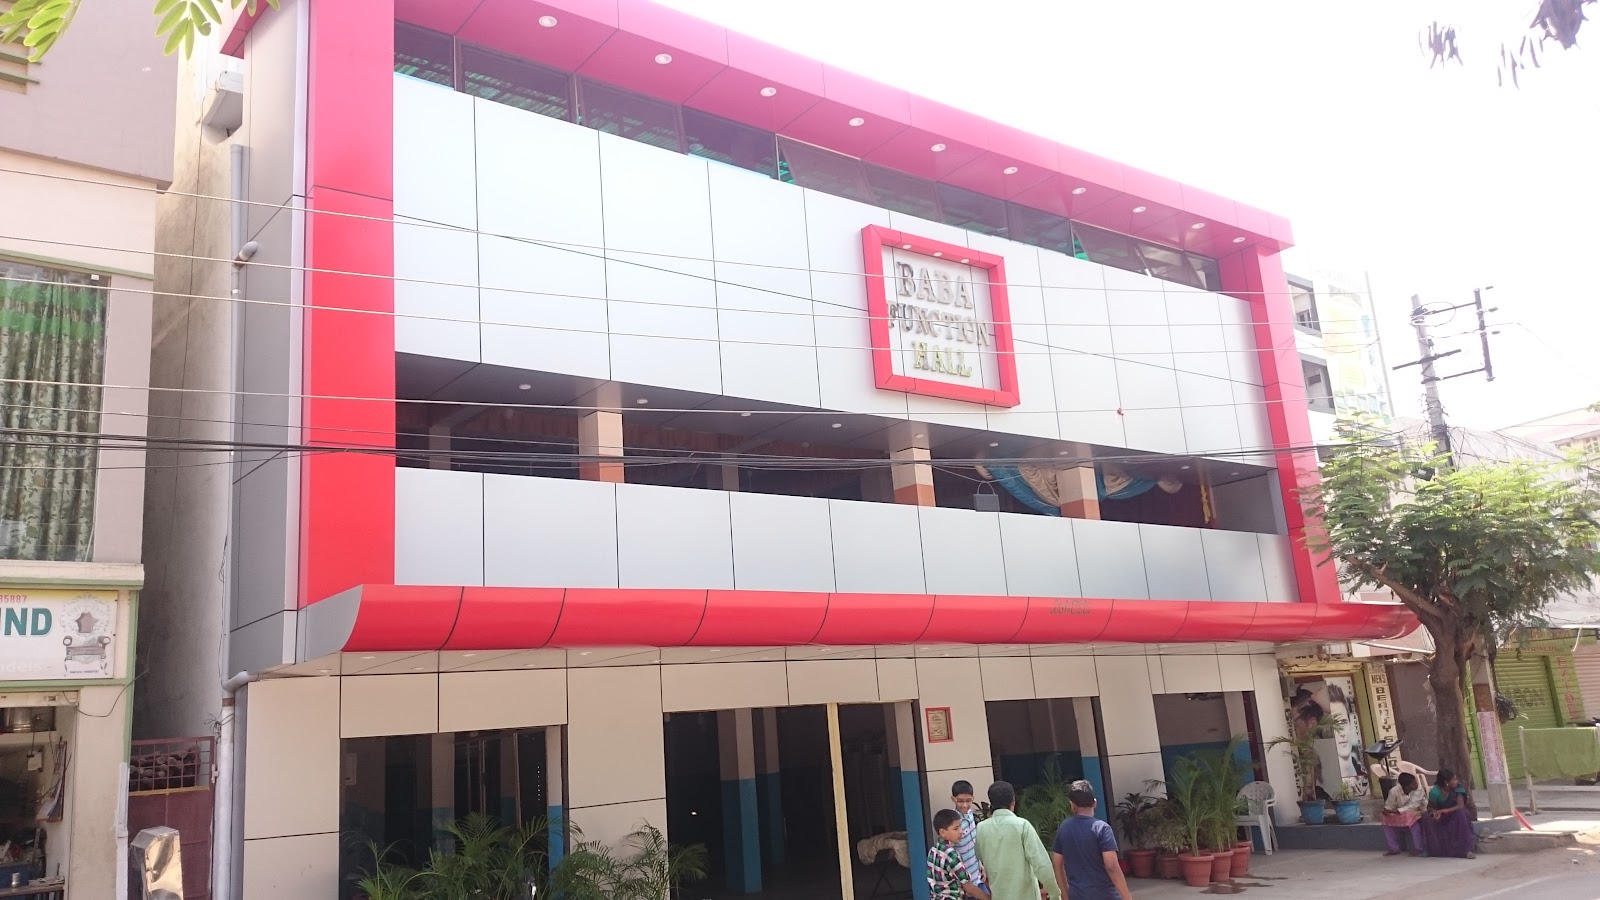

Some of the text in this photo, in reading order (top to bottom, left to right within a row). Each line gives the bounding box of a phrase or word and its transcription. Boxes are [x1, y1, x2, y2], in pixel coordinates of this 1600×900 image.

[896, 261, 973, 310] BABA
[887, 300, 990, 347] FUNCTION
[912, 340, 973, 378] HALL
[0, 606, 52, 637] ND
